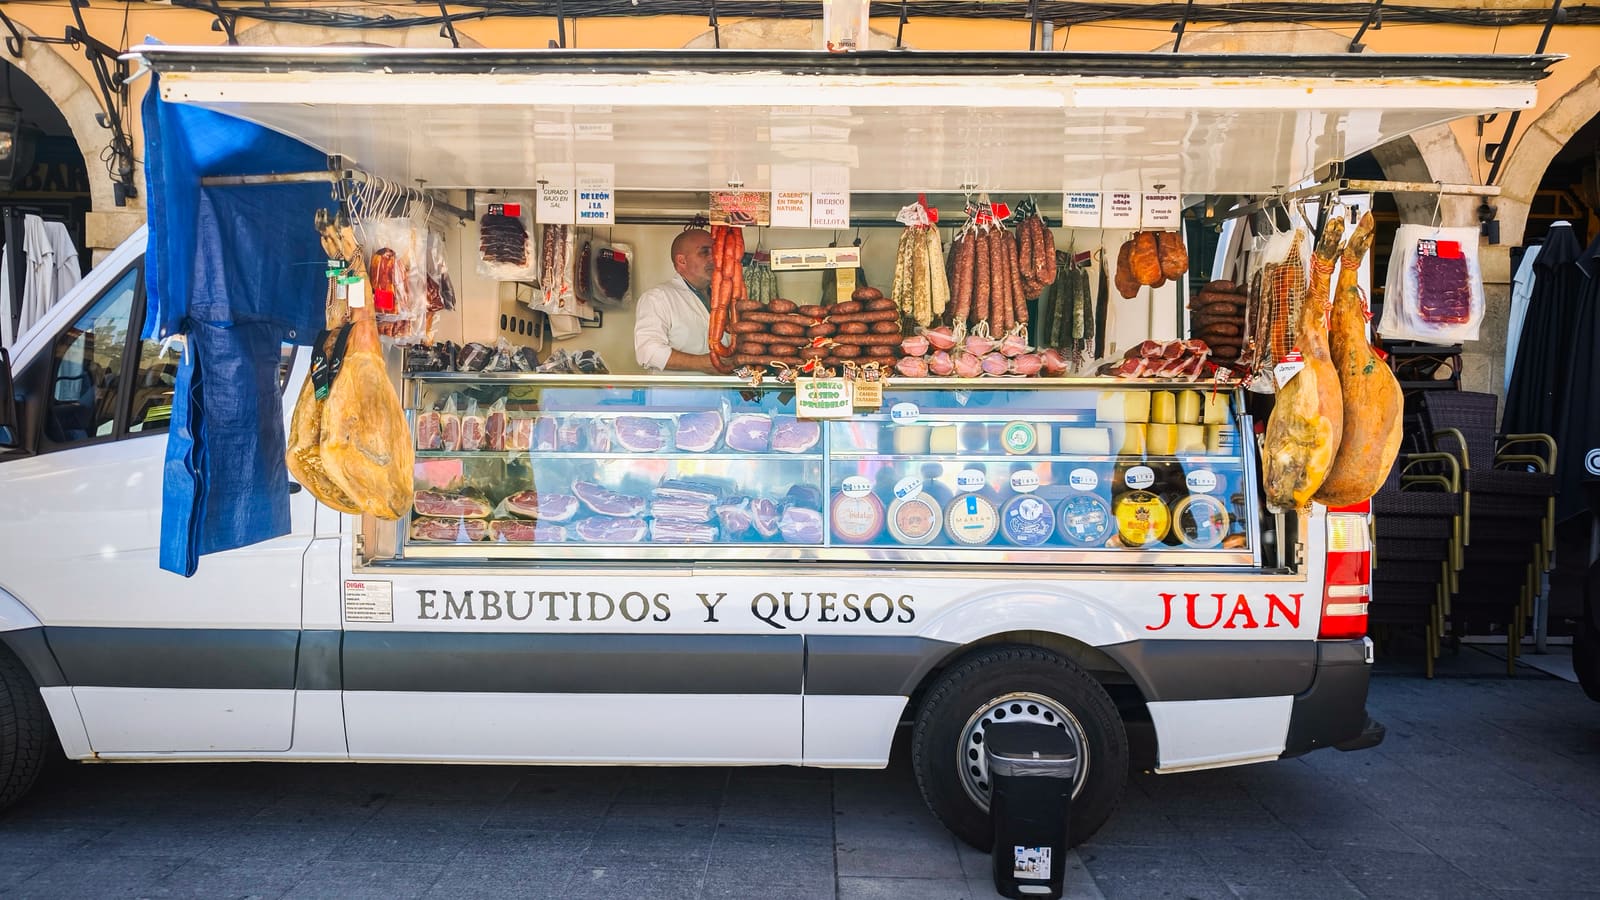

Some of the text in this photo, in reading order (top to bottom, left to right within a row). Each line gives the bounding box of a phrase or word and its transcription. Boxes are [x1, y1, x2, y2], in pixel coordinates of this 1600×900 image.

[417, 590, 917, 629] EMBUTIDOS Y QUESOS
[1145, 593, 1305, 630] JUAN
